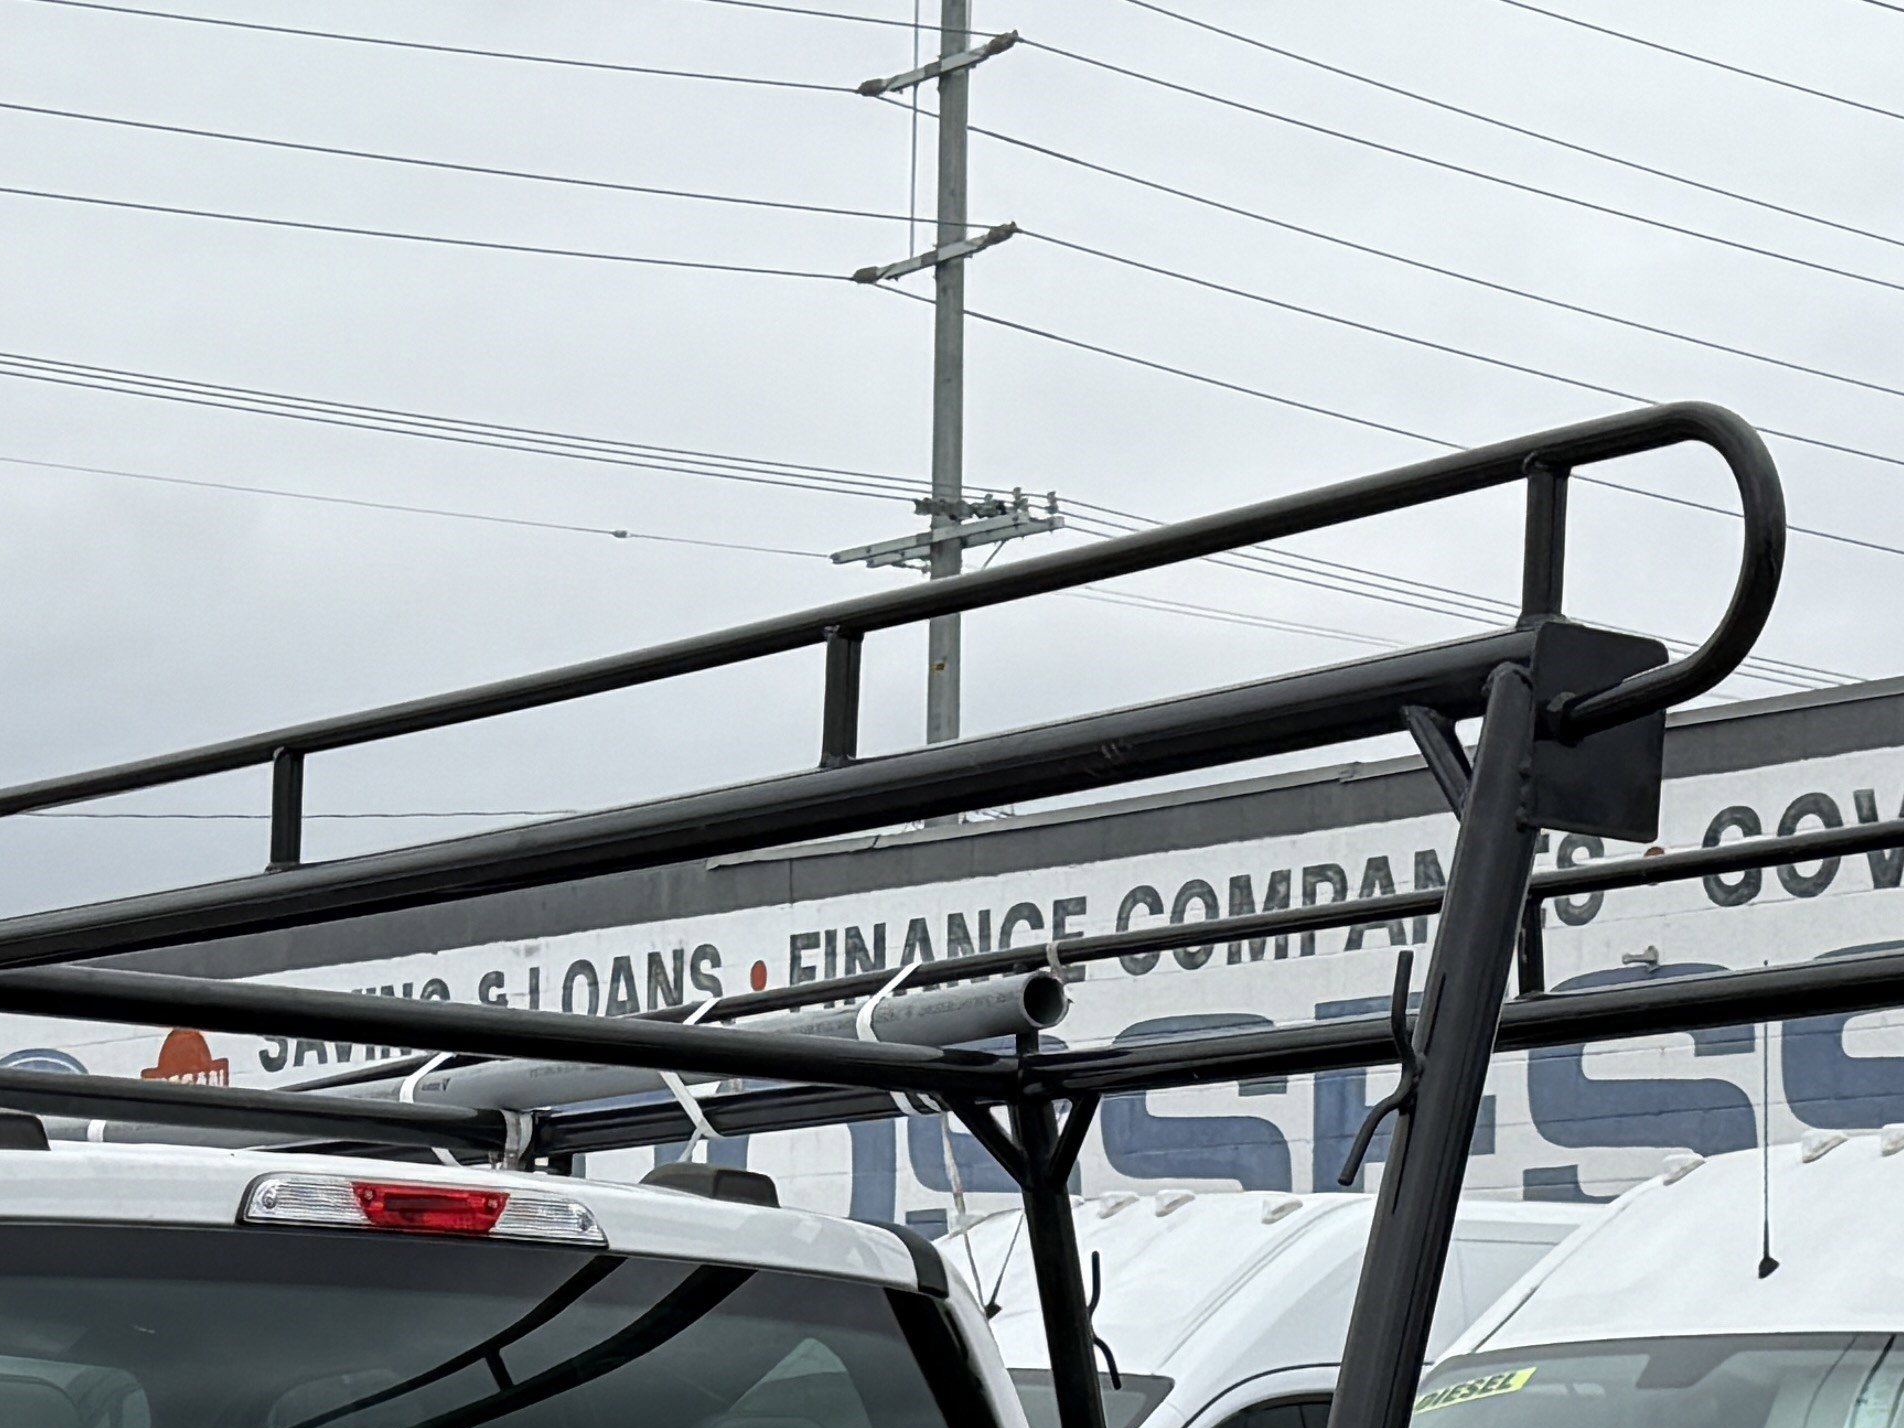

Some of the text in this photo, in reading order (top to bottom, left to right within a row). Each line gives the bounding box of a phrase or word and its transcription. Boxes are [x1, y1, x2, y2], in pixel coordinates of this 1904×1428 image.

[790, 896, 1088, 1012] FINANCE
[1116, 833, 1605, 976] COMPANS
[1415, 1371, 1517, 1411] DIESEL
